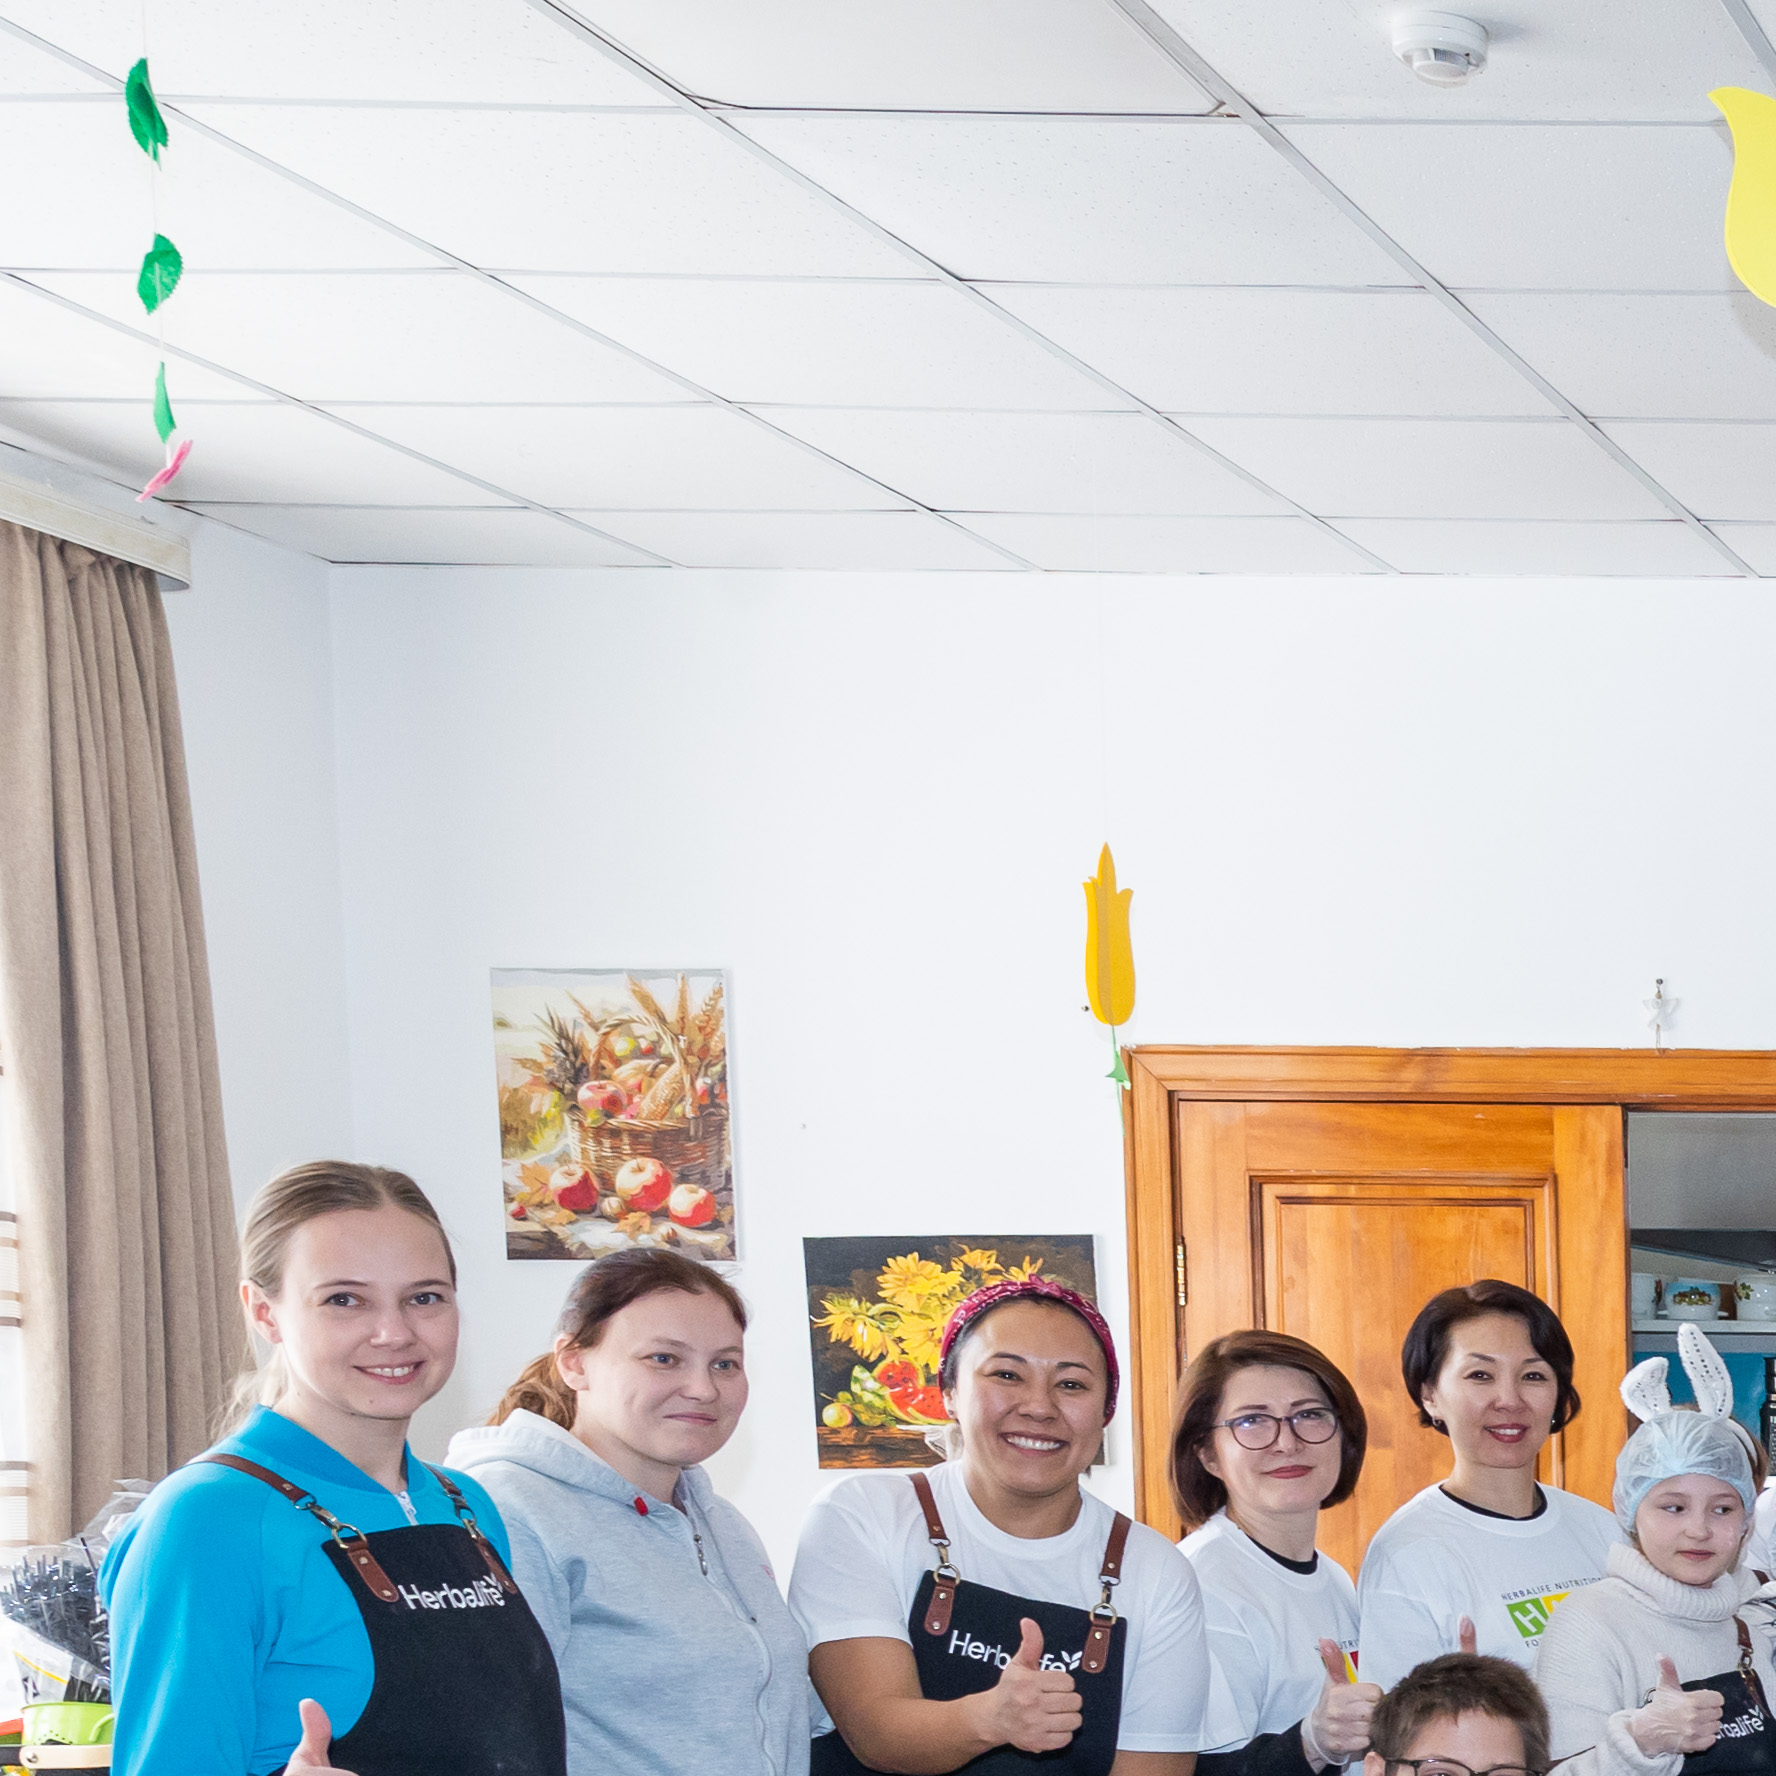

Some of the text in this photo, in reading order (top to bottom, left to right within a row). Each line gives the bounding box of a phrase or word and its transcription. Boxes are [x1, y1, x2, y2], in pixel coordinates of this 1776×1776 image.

[397, 1579, 506, 1610] Herbalife
[1501, 1581, 1552, 1601] HERBALIFE
[948, 1629, 1067, 1673] Herbfe
